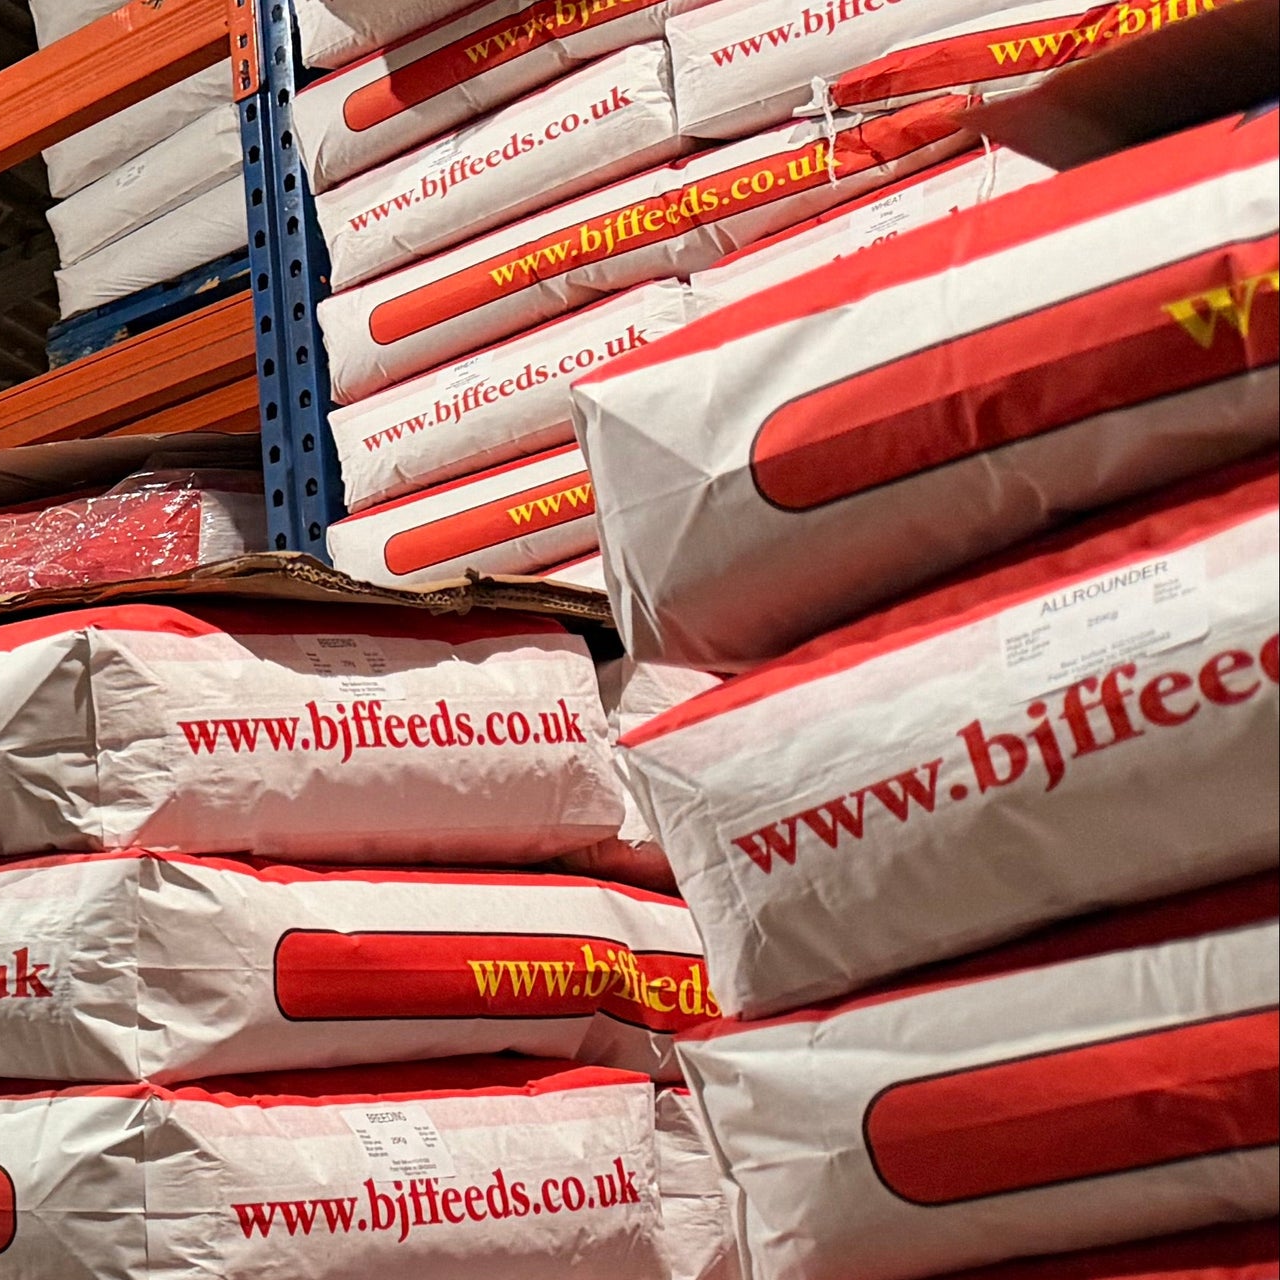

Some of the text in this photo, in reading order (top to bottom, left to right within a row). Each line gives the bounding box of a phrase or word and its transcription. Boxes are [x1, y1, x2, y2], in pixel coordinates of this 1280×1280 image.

[348, 85, 631, 232] www.bjffeeds.co.uk
[487, 149, 841, 288] www.bjffeeds.co.uk
[363, 324, 648, 451] www.bjffeeds.co.uk
[1039, 561, 1169, 617] ALLROUNDER
[177, 700, 586, 763] www.bjffeeds.co.uk
[231, 1157, 640, 1243] www.bjffeeds.co.uk
